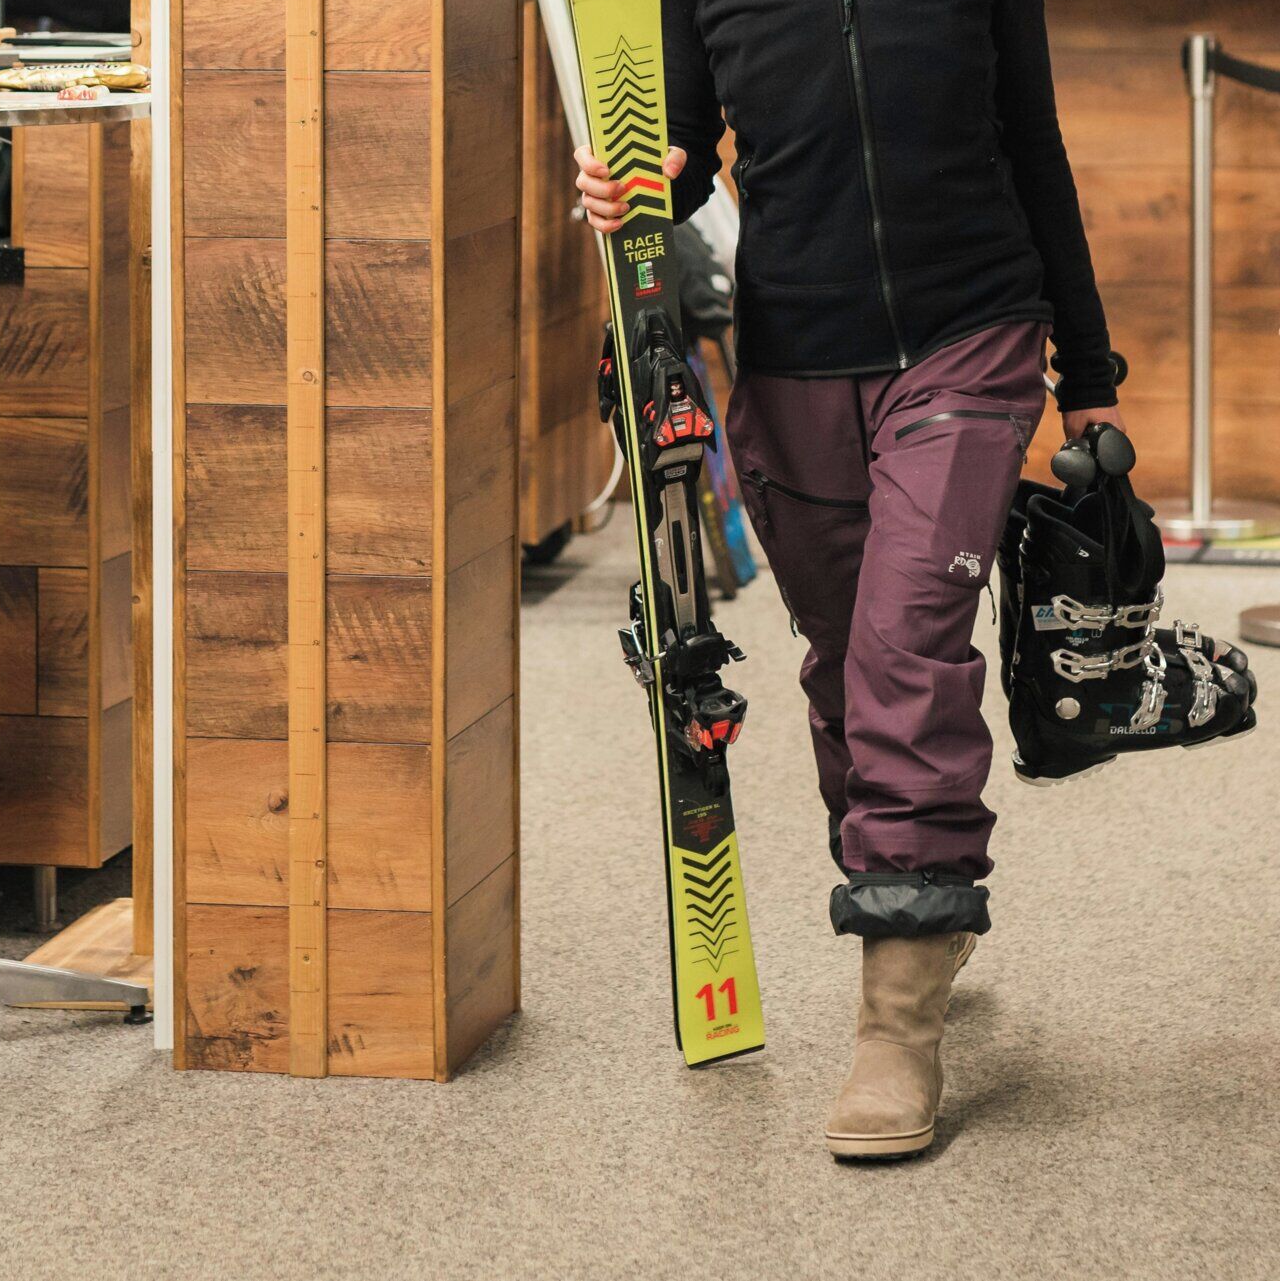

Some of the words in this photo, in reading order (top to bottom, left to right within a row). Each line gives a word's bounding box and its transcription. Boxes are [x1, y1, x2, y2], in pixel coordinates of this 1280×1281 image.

[623, 232, 665, 252] RACE
[625, 245, 666, 264] TIGER
[695, 976, 738, 1022] 11
